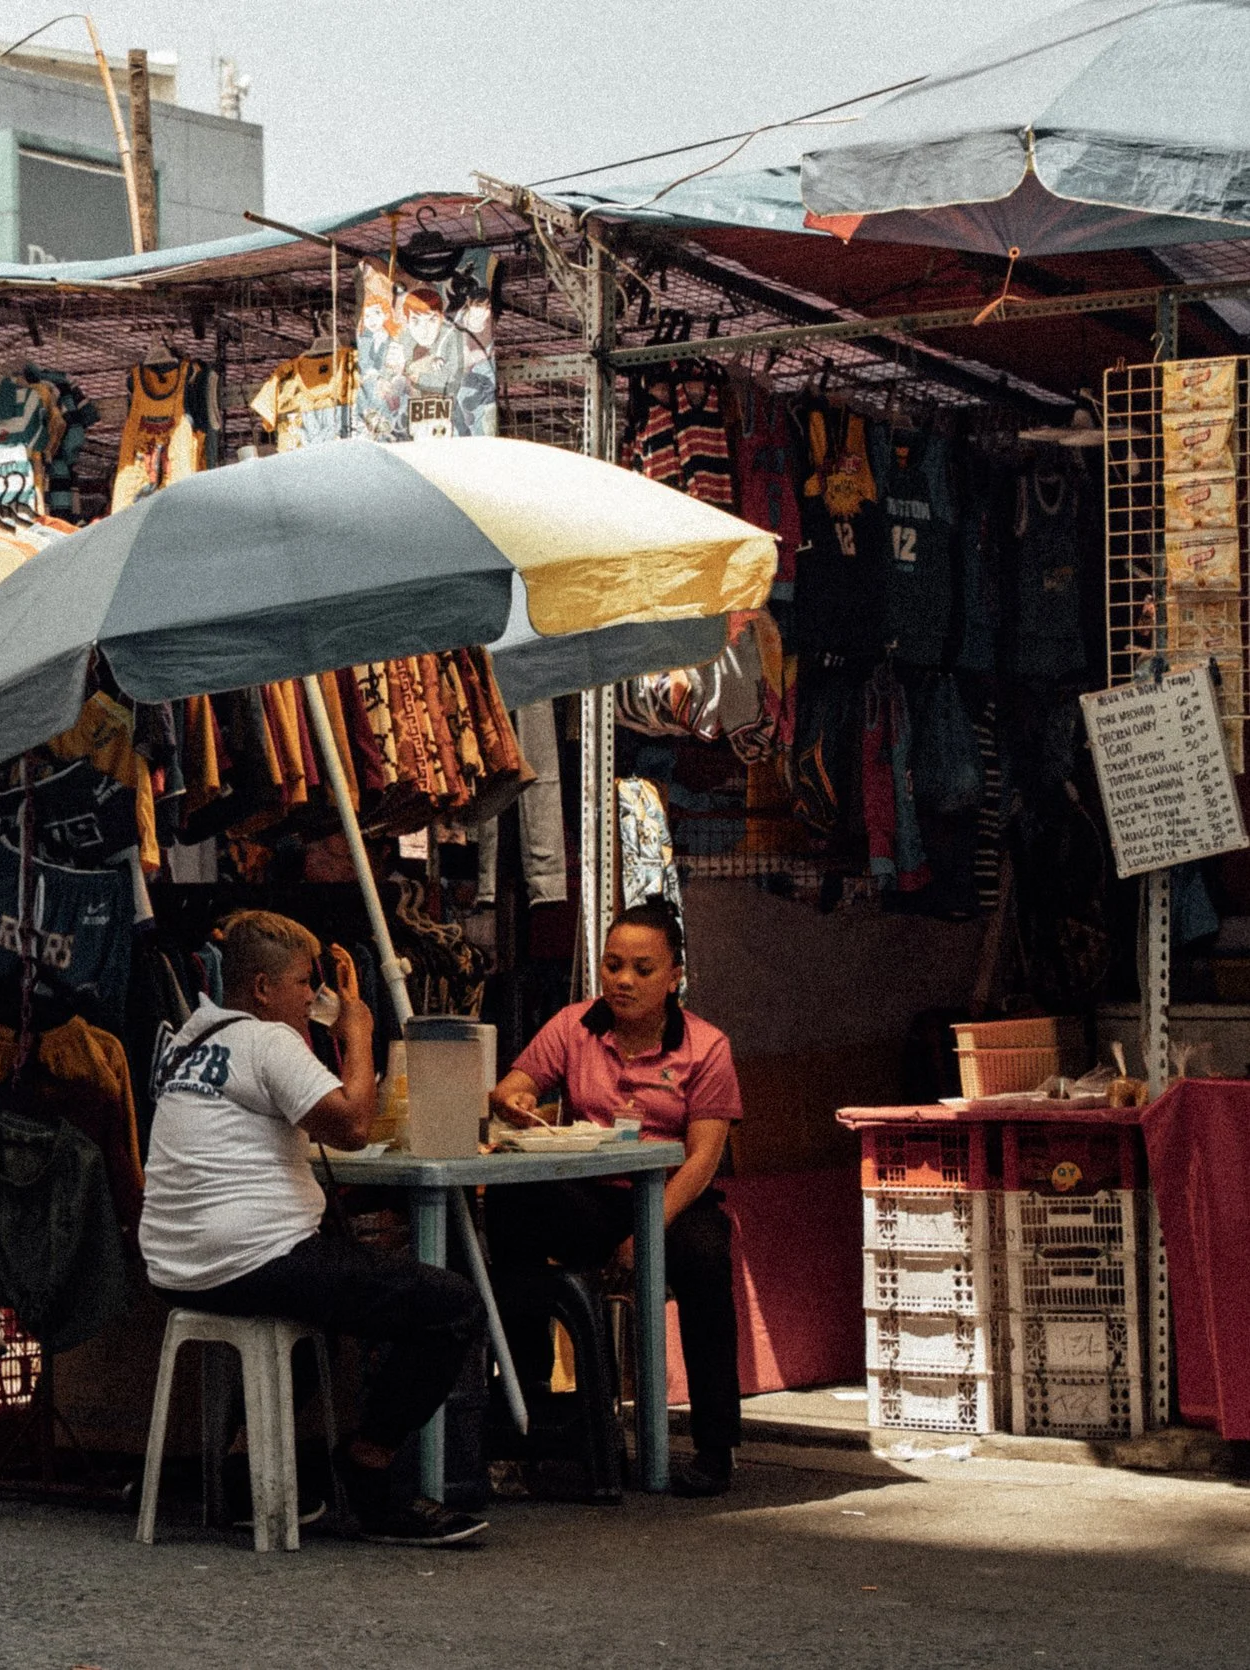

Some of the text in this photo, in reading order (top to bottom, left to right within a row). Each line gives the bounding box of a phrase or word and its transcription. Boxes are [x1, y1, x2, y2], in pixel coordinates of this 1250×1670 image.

[411, 400, 450, 422] BEN
[891, 525, 917, 562] 12
[1121, 688, 1135, 700] FOR
[1096, 713, 1116, 731] PORK
[1097, 727, 1132, 746] CHICKEN
[1132, 718, 1157, 736] CURRY
[1104, 742, 1133, 760] IGADO
